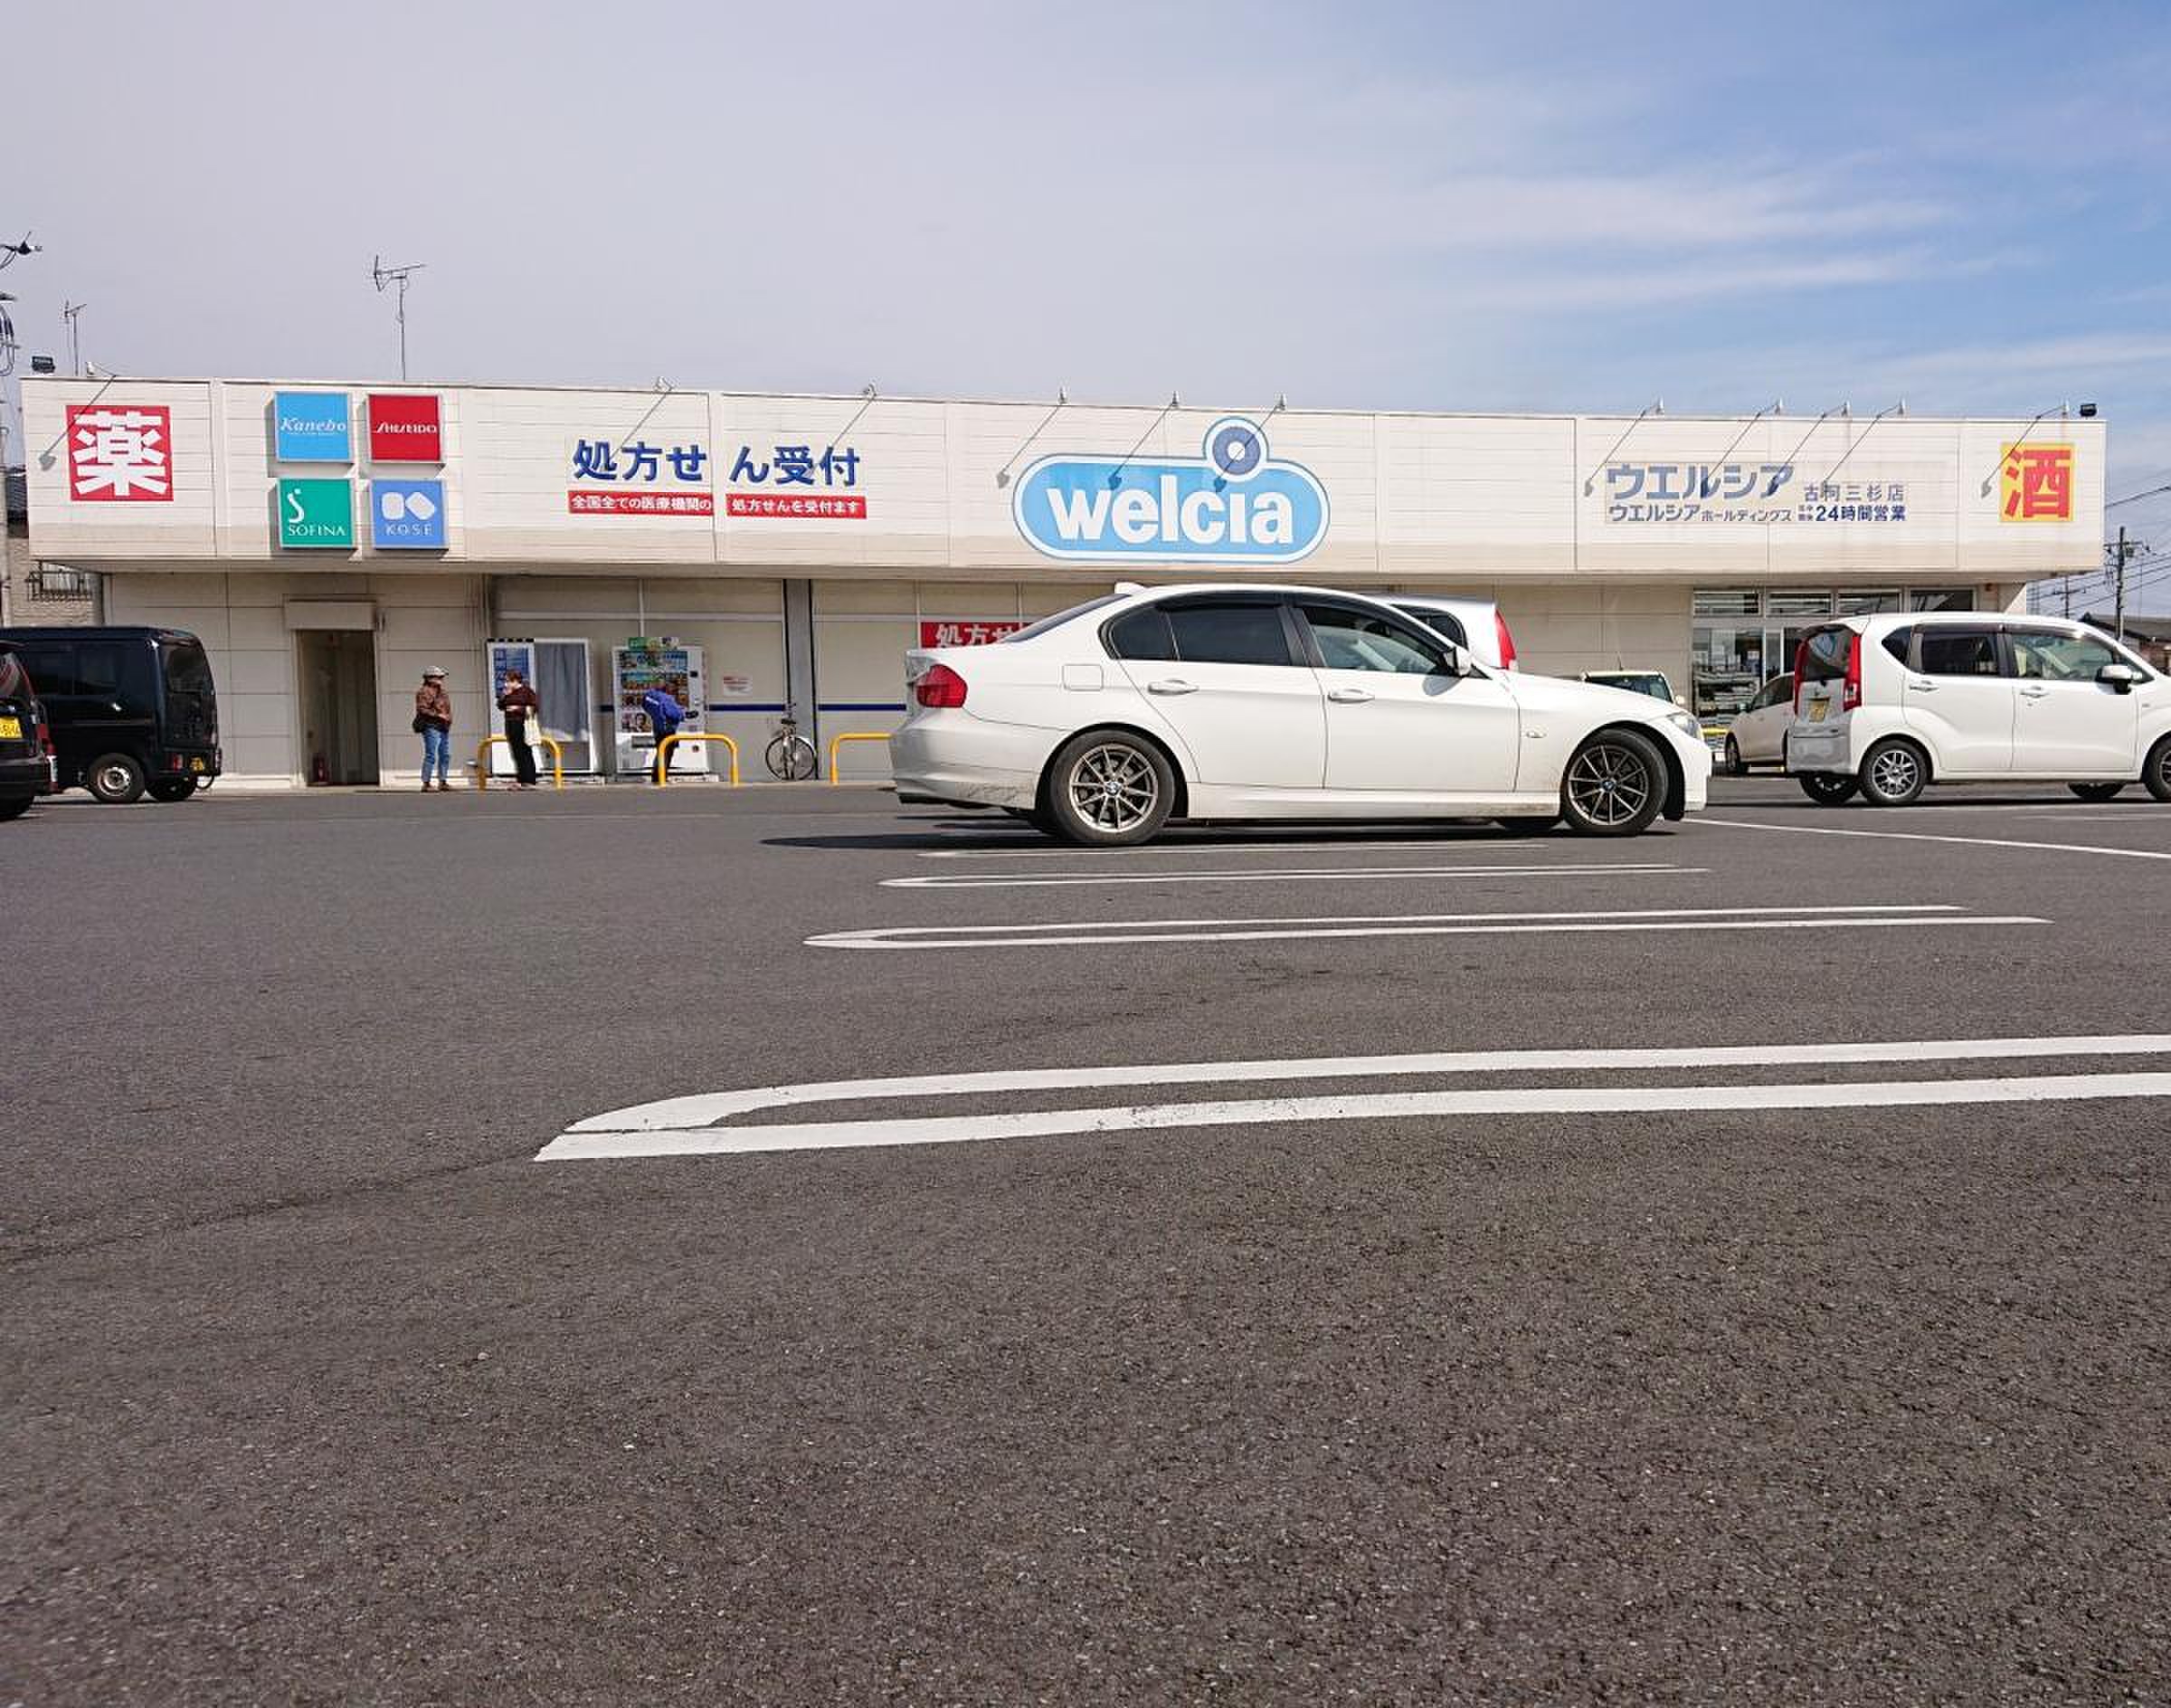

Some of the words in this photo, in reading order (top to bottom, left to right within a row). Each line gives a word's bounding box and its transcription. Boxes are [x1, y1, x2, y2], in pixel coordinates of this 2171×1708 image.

[280, 418, 346, 432] Kanebo
[375, 422, 437, 433] SHISEIDO
[72, 411, 169, 496] 薬
[1607, 464, 1794, 499] ウエルシア
[2005, 451, 2070, 517] 酒
[1046, 475, 1294, 544] welcia
[289, 524, 346, 536] SOFINA
